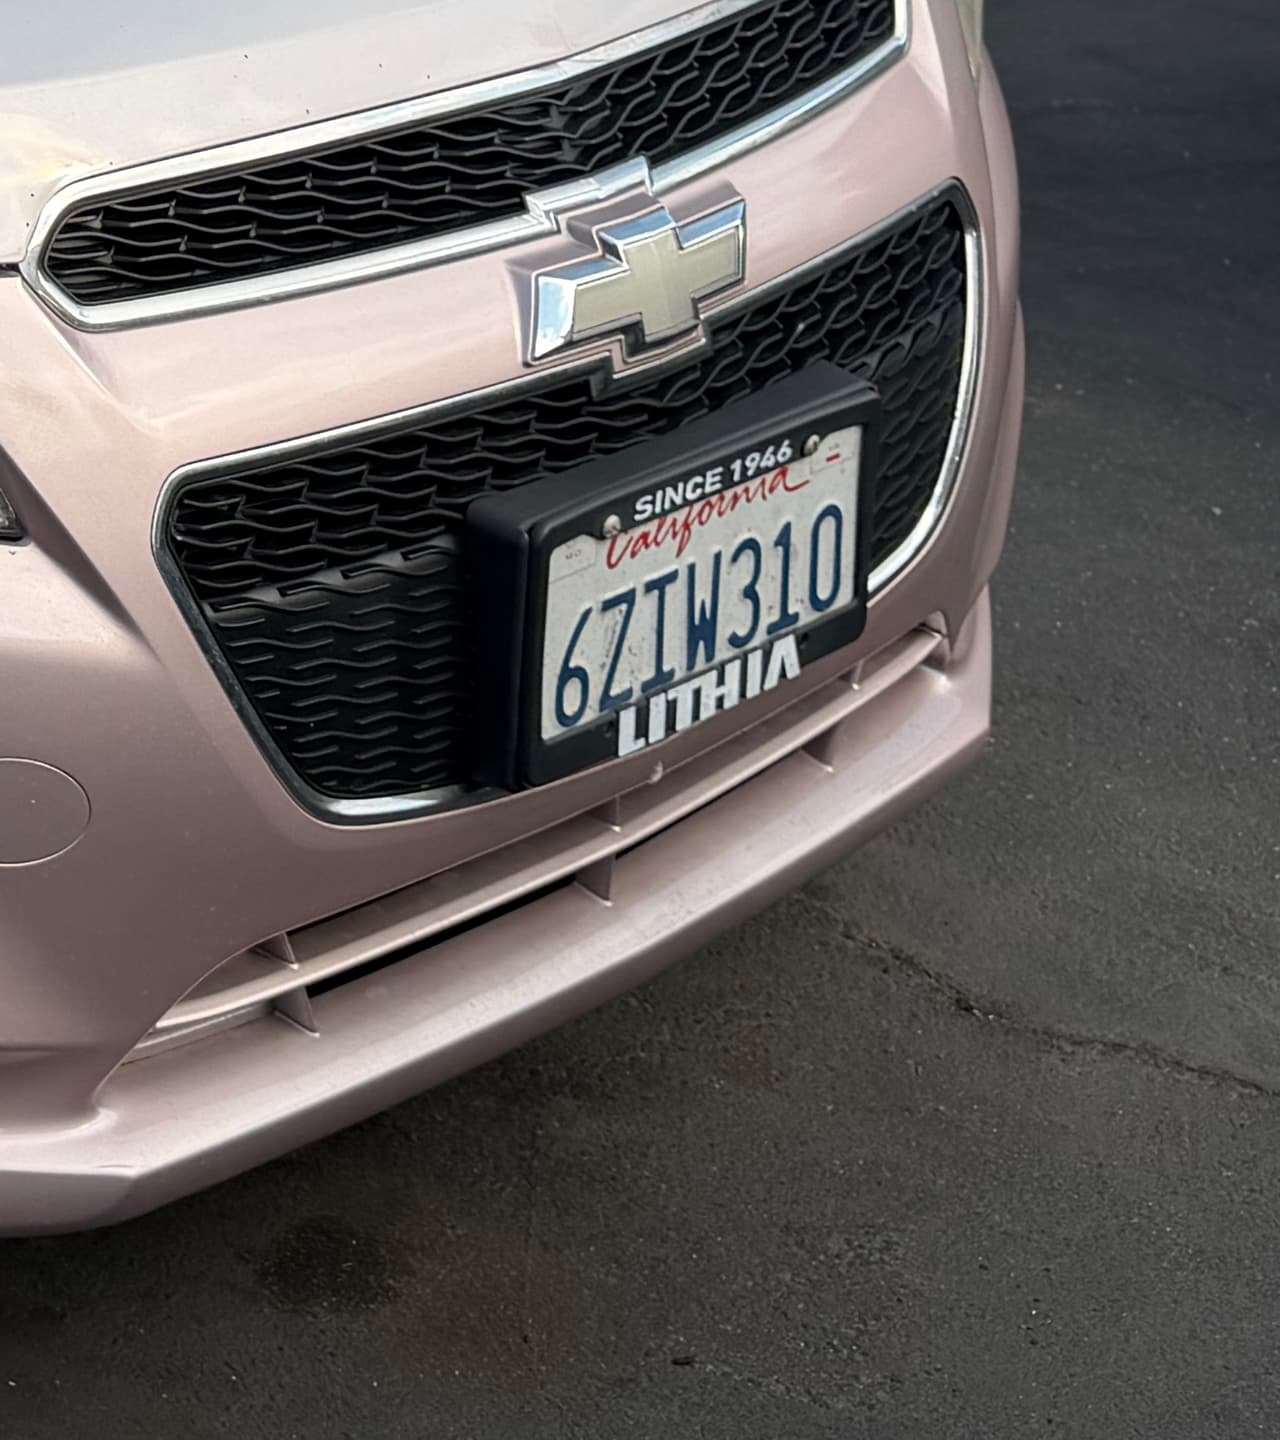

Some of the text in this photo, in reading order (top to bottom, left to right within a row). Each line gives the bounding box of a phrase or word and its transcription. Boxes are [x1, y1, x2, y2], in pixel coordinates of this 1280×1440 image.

[605, 464, 810, 570] California
[633, 439, 794, 523] SINCE 1946
[553, 503, 844, 728] 6ZIW310
[617, 633, 802, 758] LITHIA
